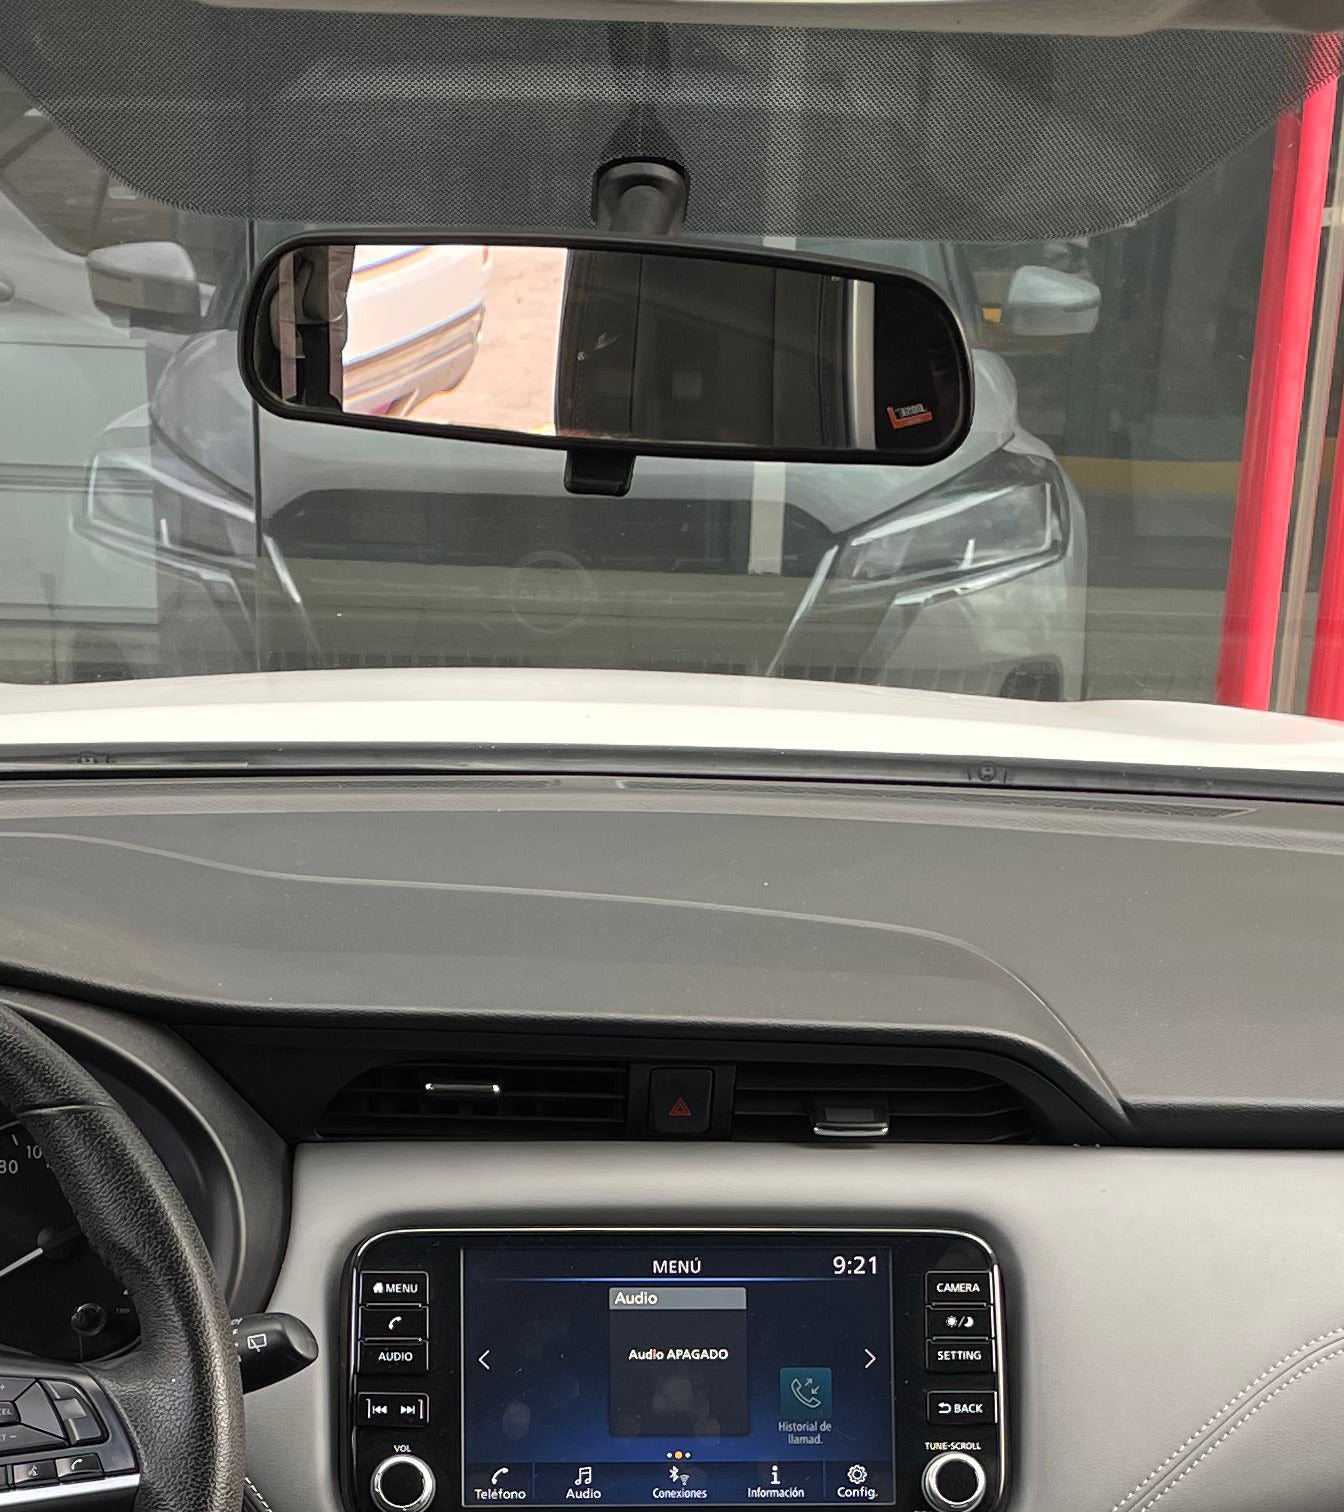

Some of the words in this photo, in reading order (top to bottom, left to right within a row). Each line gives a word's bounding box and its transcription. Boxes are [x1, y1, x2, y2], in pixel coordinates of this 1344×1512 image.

[25, 1144, 43, 1160] 10
[652, 1256, 702, 1274] MENÚ
[832, 1255, 877, 1275] 9:21
[385, 1283, 419, 1294] MENU
[936, 1282, 981, 1293] CAMERA
[614, 1291, 658, 1305] Audio
[378, 1351, 413, 1362] AUDIO
[628, 1348, 664, 1361] Audio
[666, 1349, 729, 1361] APAGADO
[937, 1350, 982, 1361] SETTING
[954, 1403, 984, 1414] BACK
[778, 1420, 818, 1432] Historial
[819, 1420, 832, 1432] de
[787, 1433, 823, 1445] llamad.
[394, 1444, 412, 1453] VOL
[474, 1488, 527, 1500] Teléfono
[565, 1487, 602, 1499] Audio
[652, 1487, 707, 1499] Conexiones
[747, 1486, 805, 1499] Información
[837, 1486, 878, 1500] Config.
